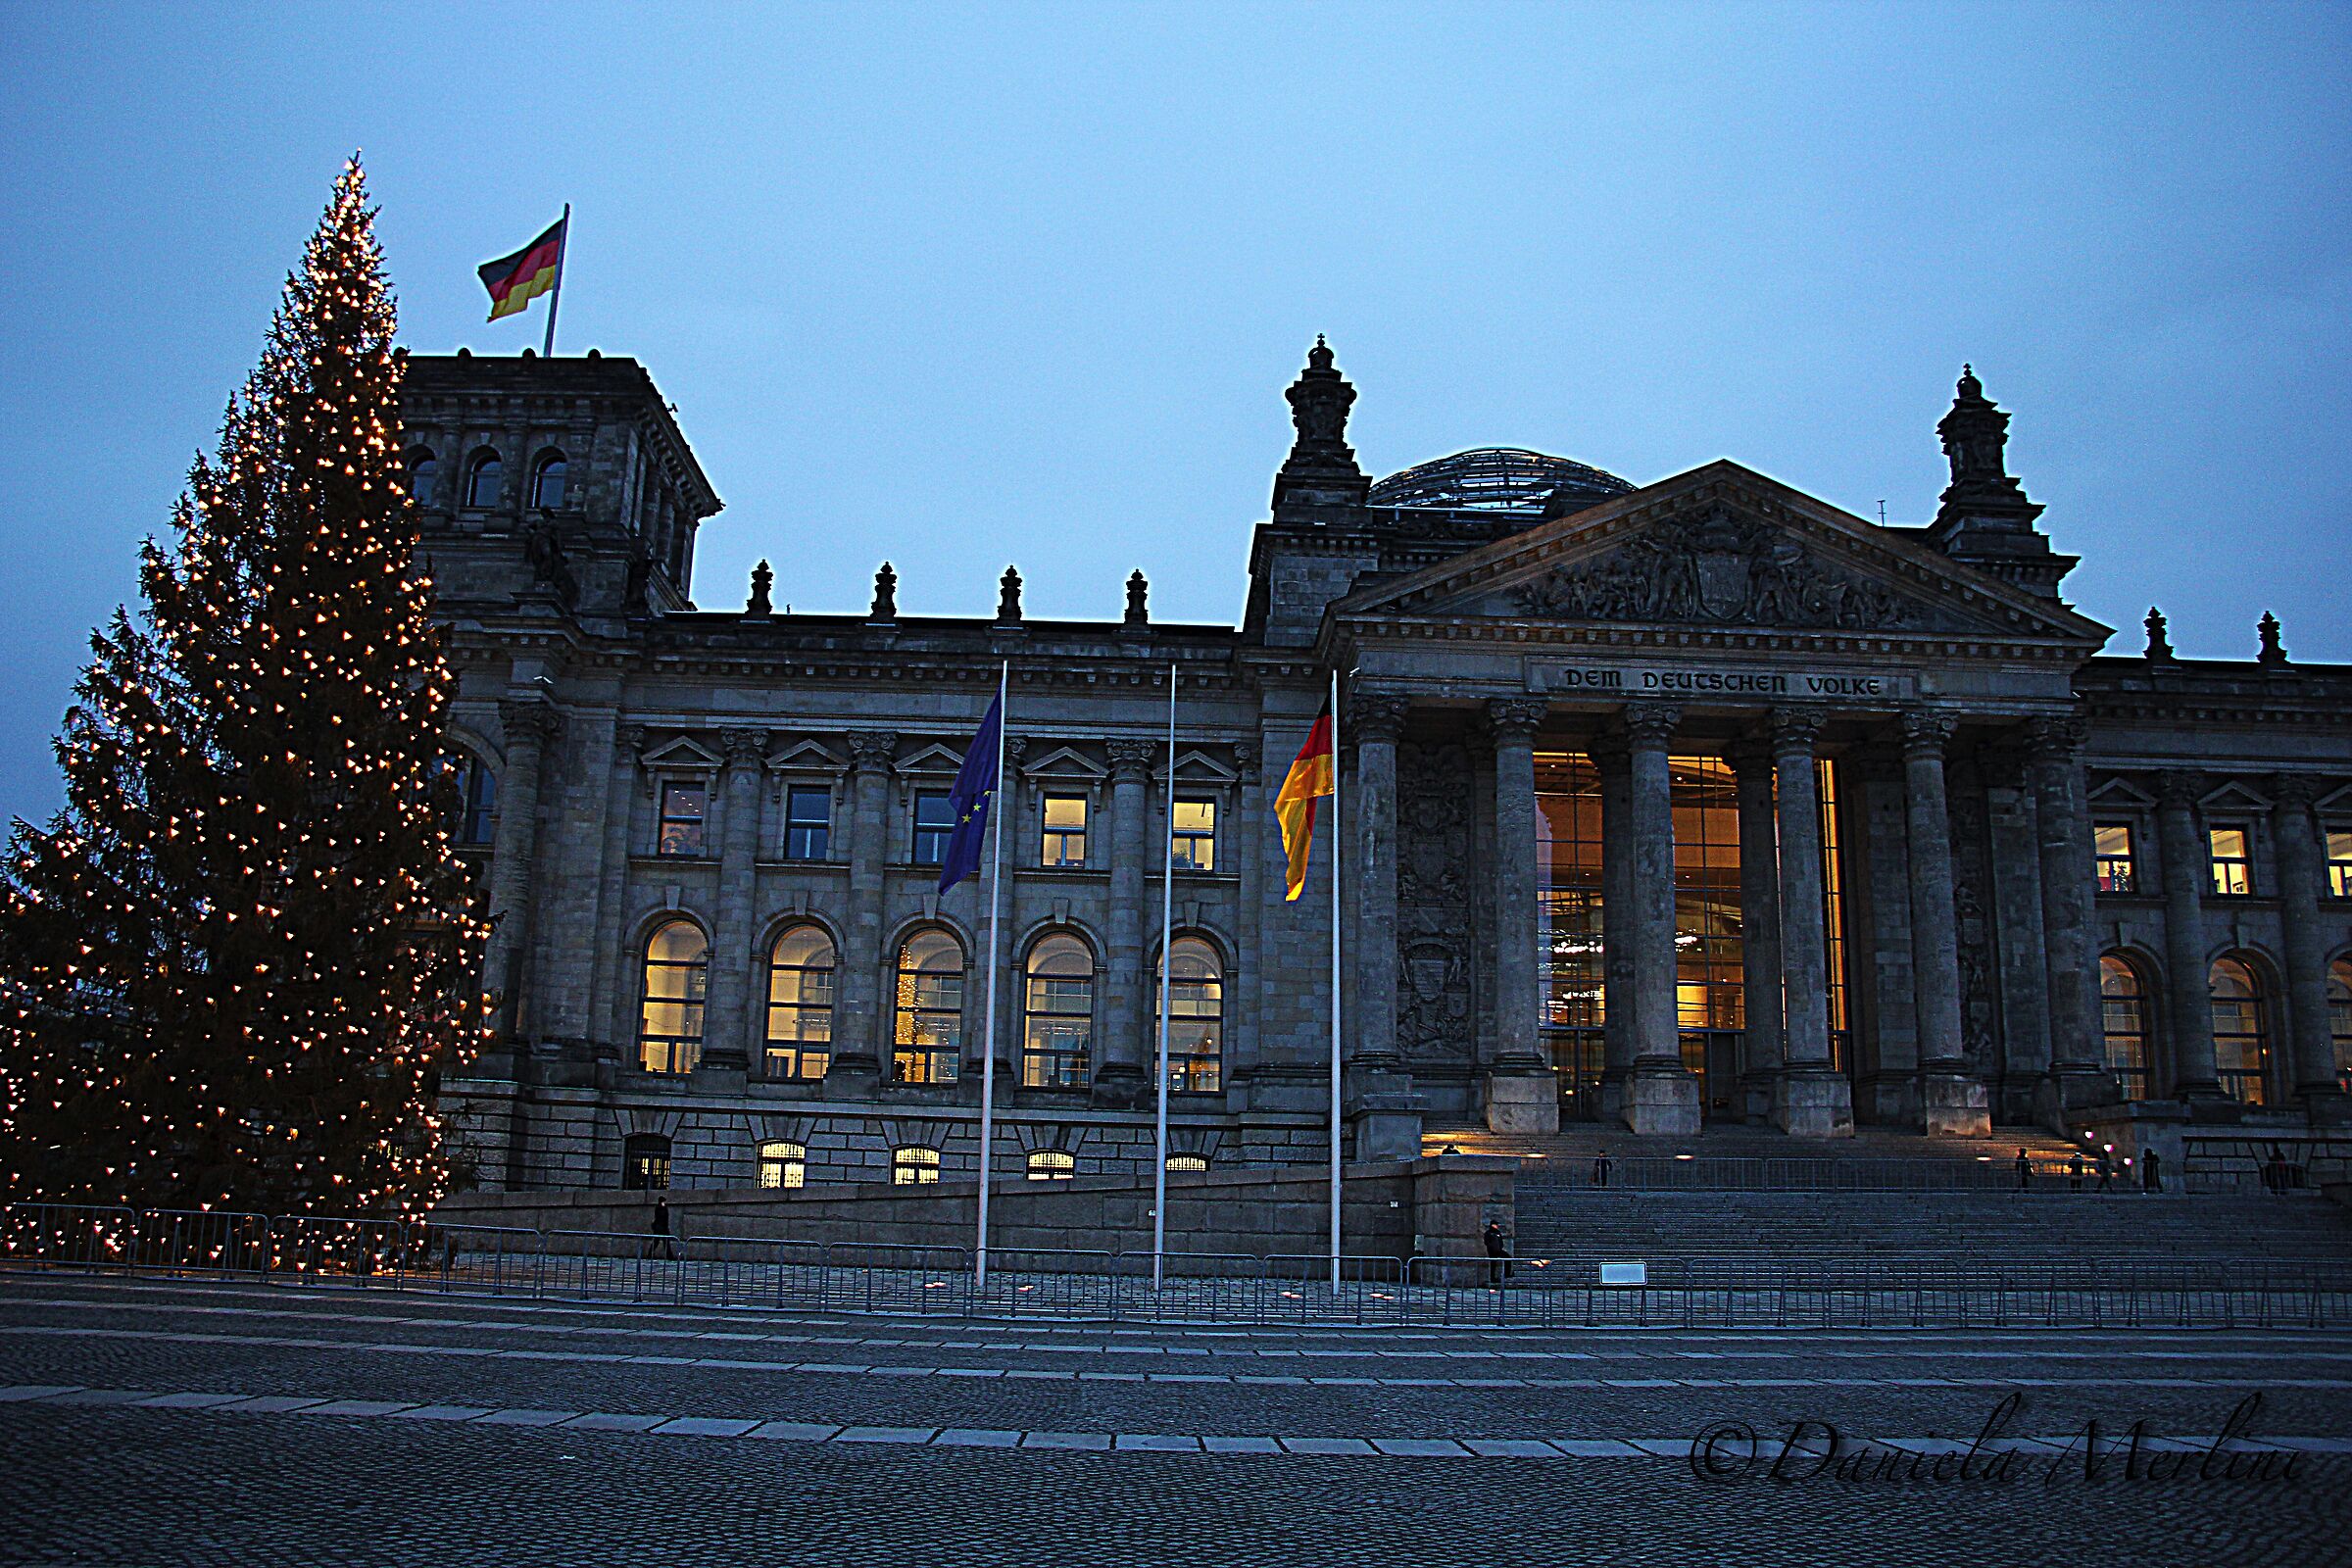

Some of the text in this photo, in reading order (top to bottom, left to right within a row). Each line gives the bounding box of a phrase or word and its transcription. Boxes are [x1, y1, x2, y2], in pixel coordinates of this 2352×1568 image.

[1565, 669, 1882, 696] DEM DEUTSCHEN VOLKE
